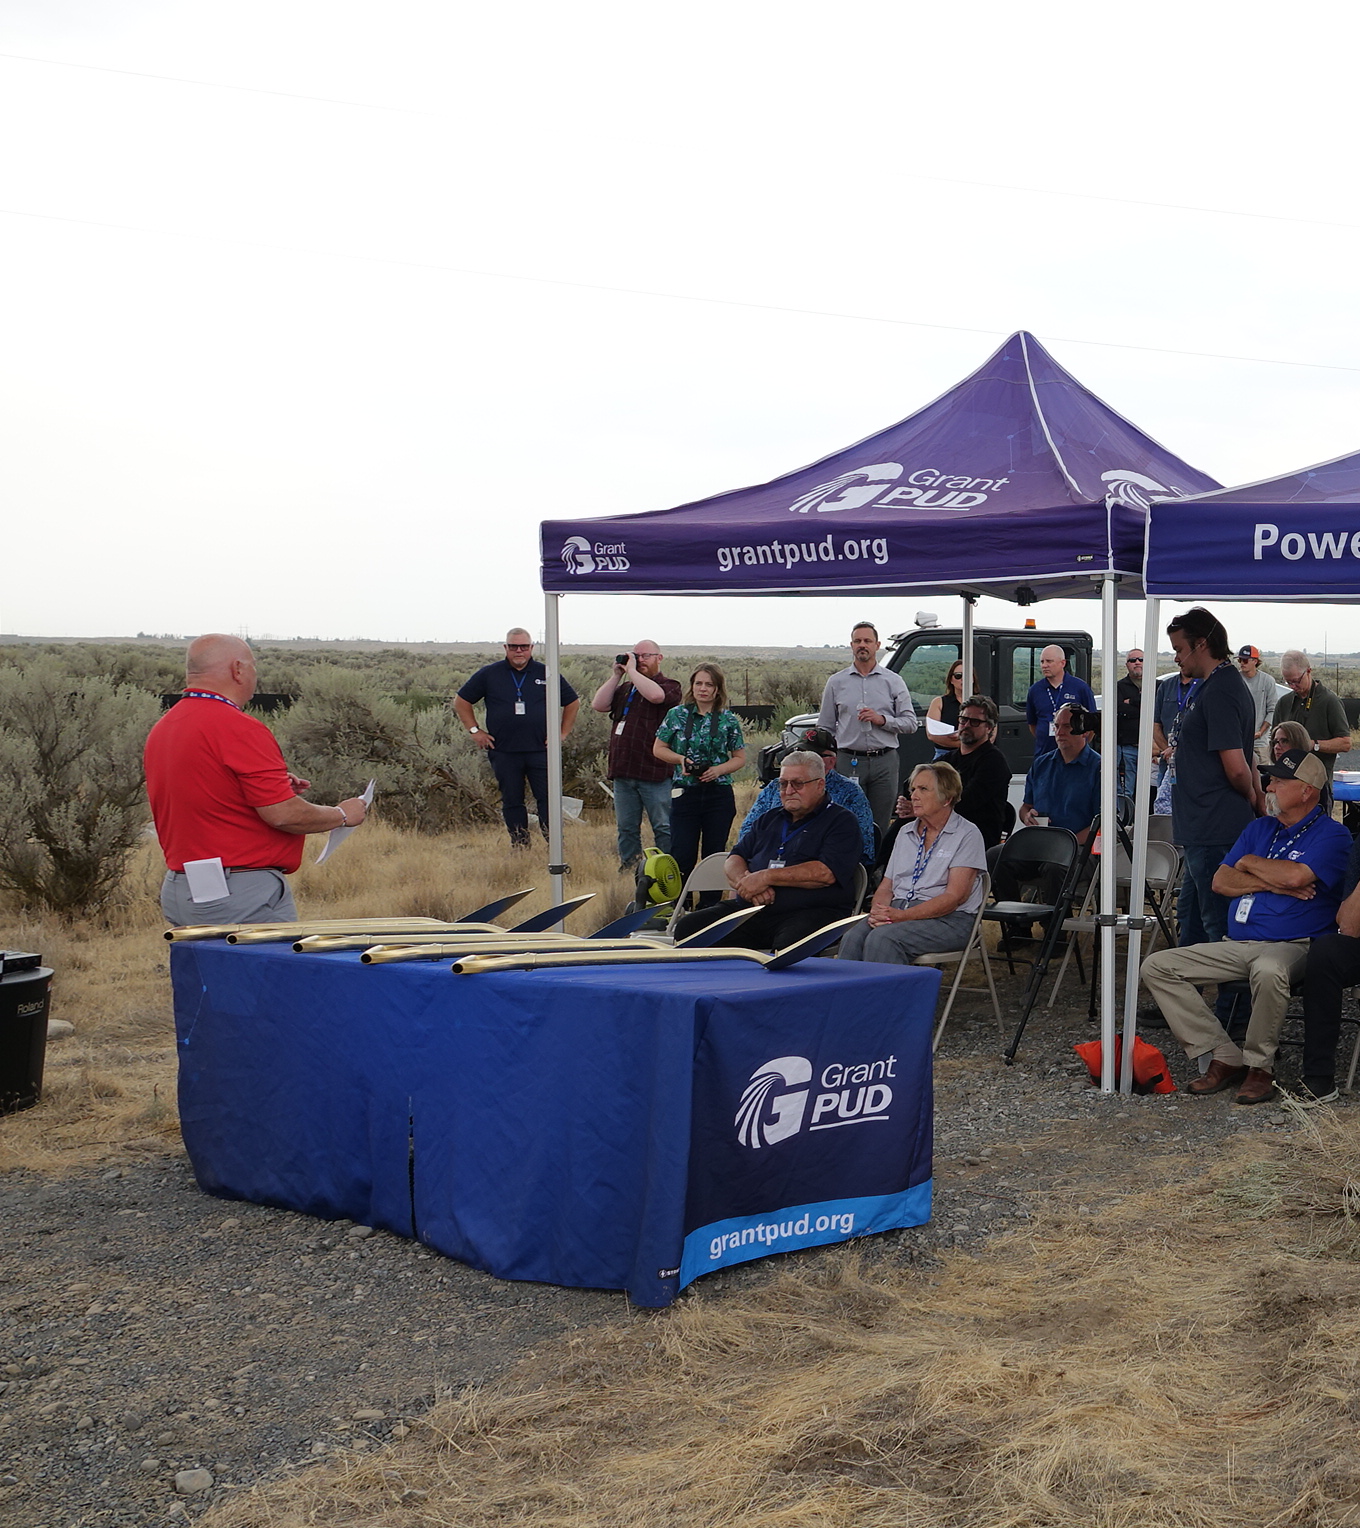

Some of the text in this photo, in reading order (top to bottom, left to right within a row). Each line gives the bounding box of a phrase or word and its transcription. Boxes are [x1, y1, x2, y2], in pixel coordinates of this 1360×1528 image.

[908, 468, 1010, 492] Grant
[877, 486, 988, 508] PUD
[594, 542, 627, 554] Grant
[716, 534, 889, 572] grantpud.org
[595, 556, 631, 570] PUD
[17, 998, 45, 1015] Roland
[821, 1054, 897, 1088] Grant
[810, 1083, 893, 1123] PUD
[709, 1212, 855, 1260] grantpud.org
